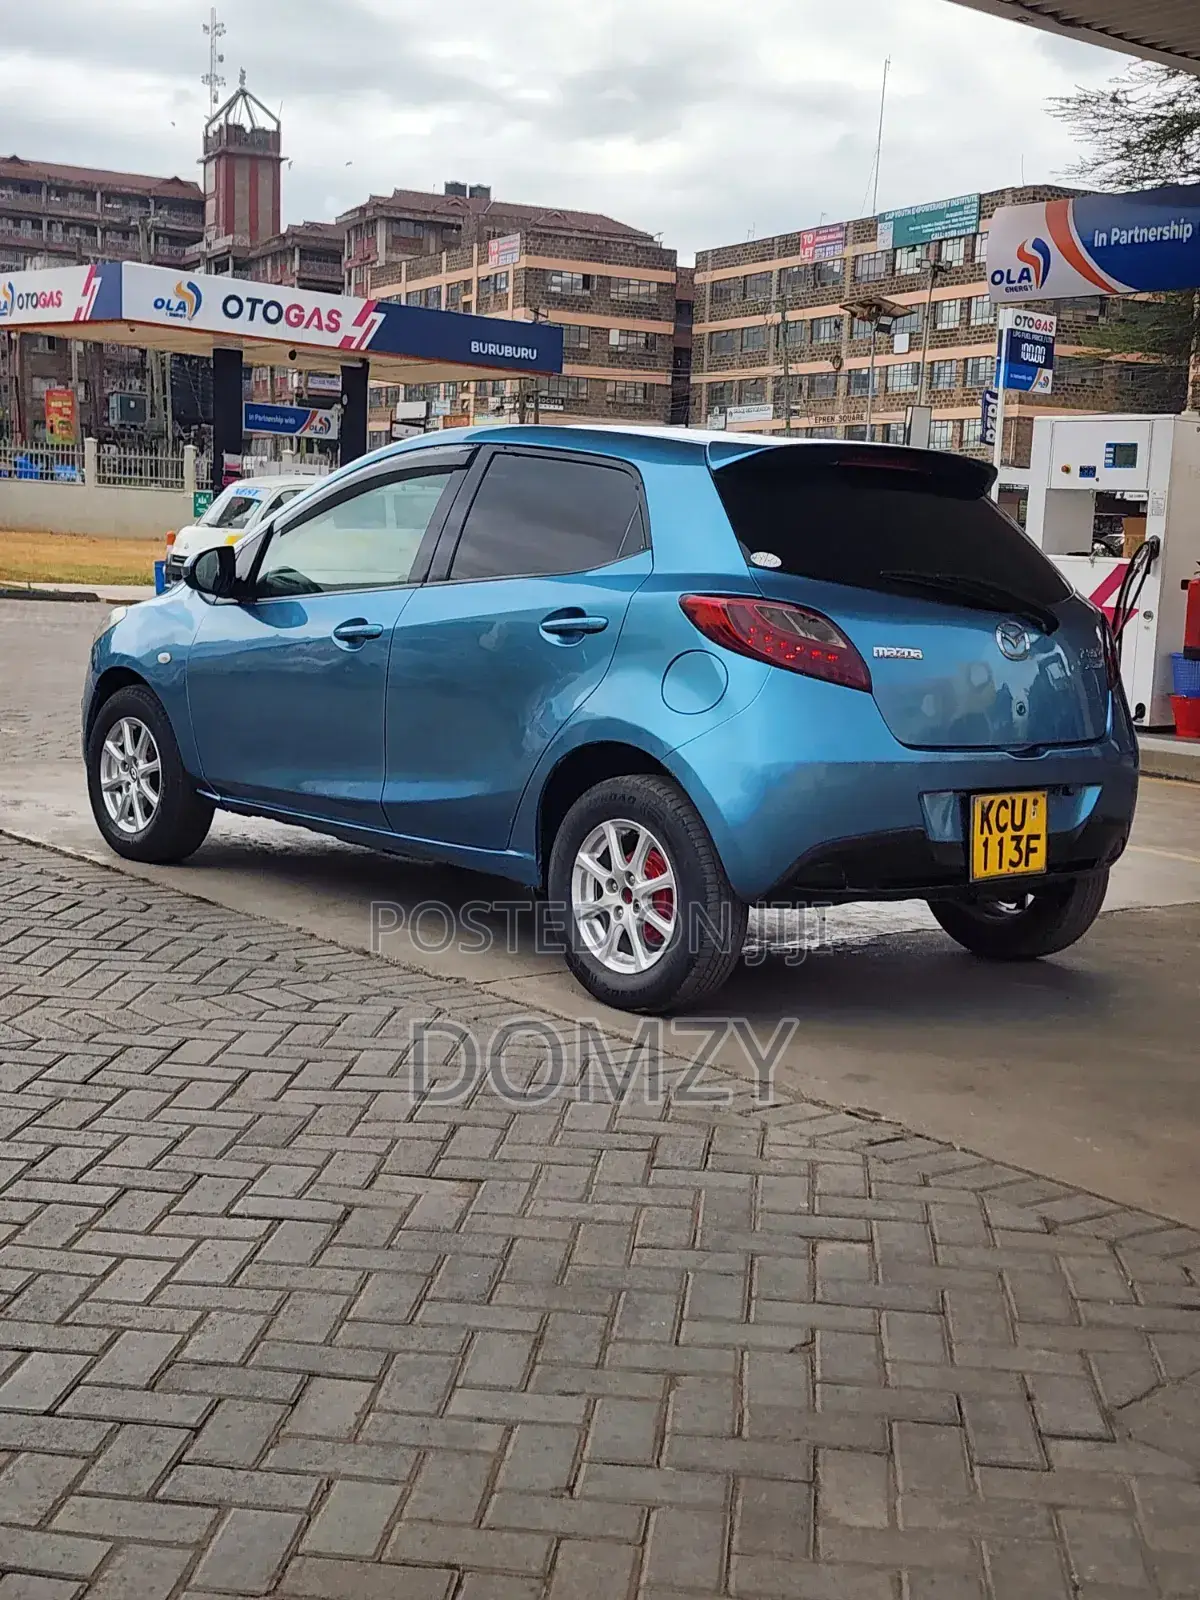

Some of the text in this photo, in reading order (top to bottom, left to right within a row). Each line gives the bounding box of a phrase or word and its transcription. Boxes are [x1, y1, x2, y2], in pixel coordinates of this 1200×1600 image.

[1094, 217, 1193, 248] In Partnership
[991, 267, 1032, 286] OLA
[1004, 284, 1033, 294] ENERGY
[17, 290, 63, 310] OTOGAS
[153, 298, 187, 313] OLA
[222, 294, 342, 333] OTOGAS
[1014, 314, 1054, 333] OTOGAS
[471, 340, 537, 360] BURUBURU
[255, 413, 284, 425] Partnership
[839, 413, 865, 423] SQUARE
[980, 798, 1028, 835] KCU
[982, 833, 1041, 872] 113F
